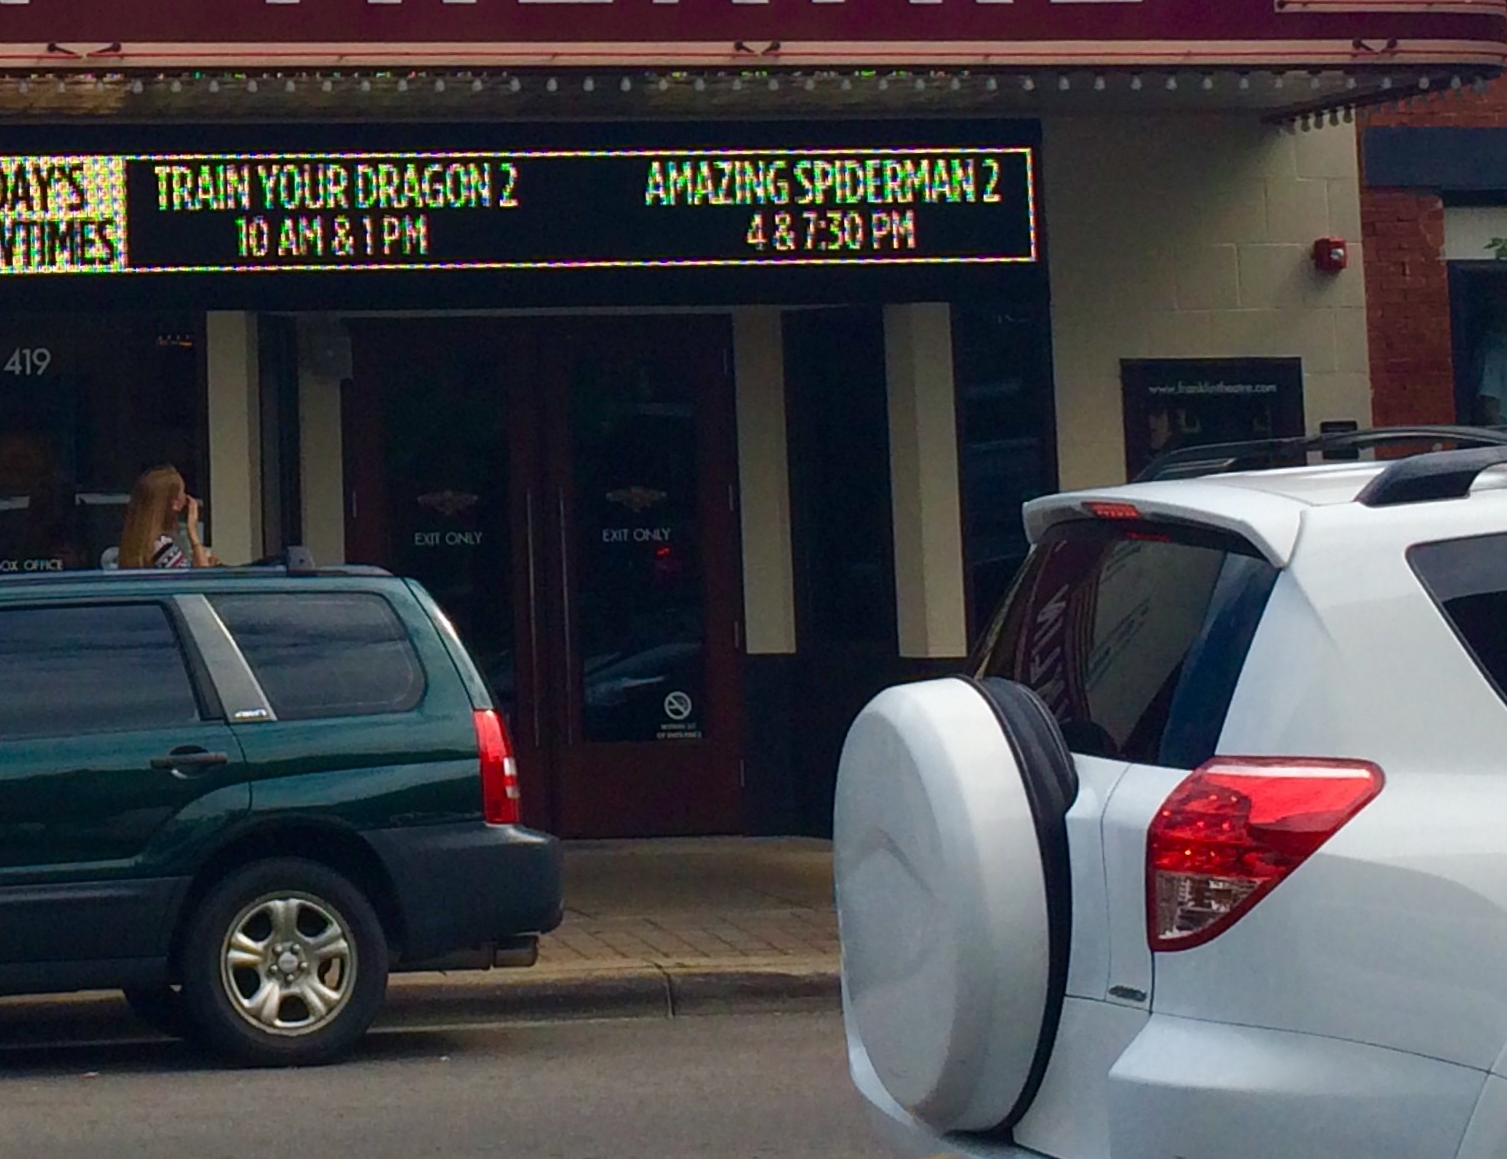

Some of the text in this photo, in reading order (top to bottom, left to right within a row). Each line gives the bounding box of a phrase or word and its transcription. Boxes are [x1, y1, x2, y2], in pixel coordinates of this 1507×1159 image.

[154, 163, 519, 210] TRAIN YOUR DRAGON 2
[645, 159, 1002, 205] AMAZING SPIDERMAN 2
[235, 215, 428, 256] 10 AM & 1 PM
[746, 210, 916, 250] 4 & 7:30 PM
[4, 348, 51, 375] 419
[1149, 381, 1277, 394] www.franklintheatre.com
[414, 531, 483, 546] EXIT ONLY
[602, 527, 671, 542] EXIT ONLY
[23, 558, 64, 571] OFFICE
